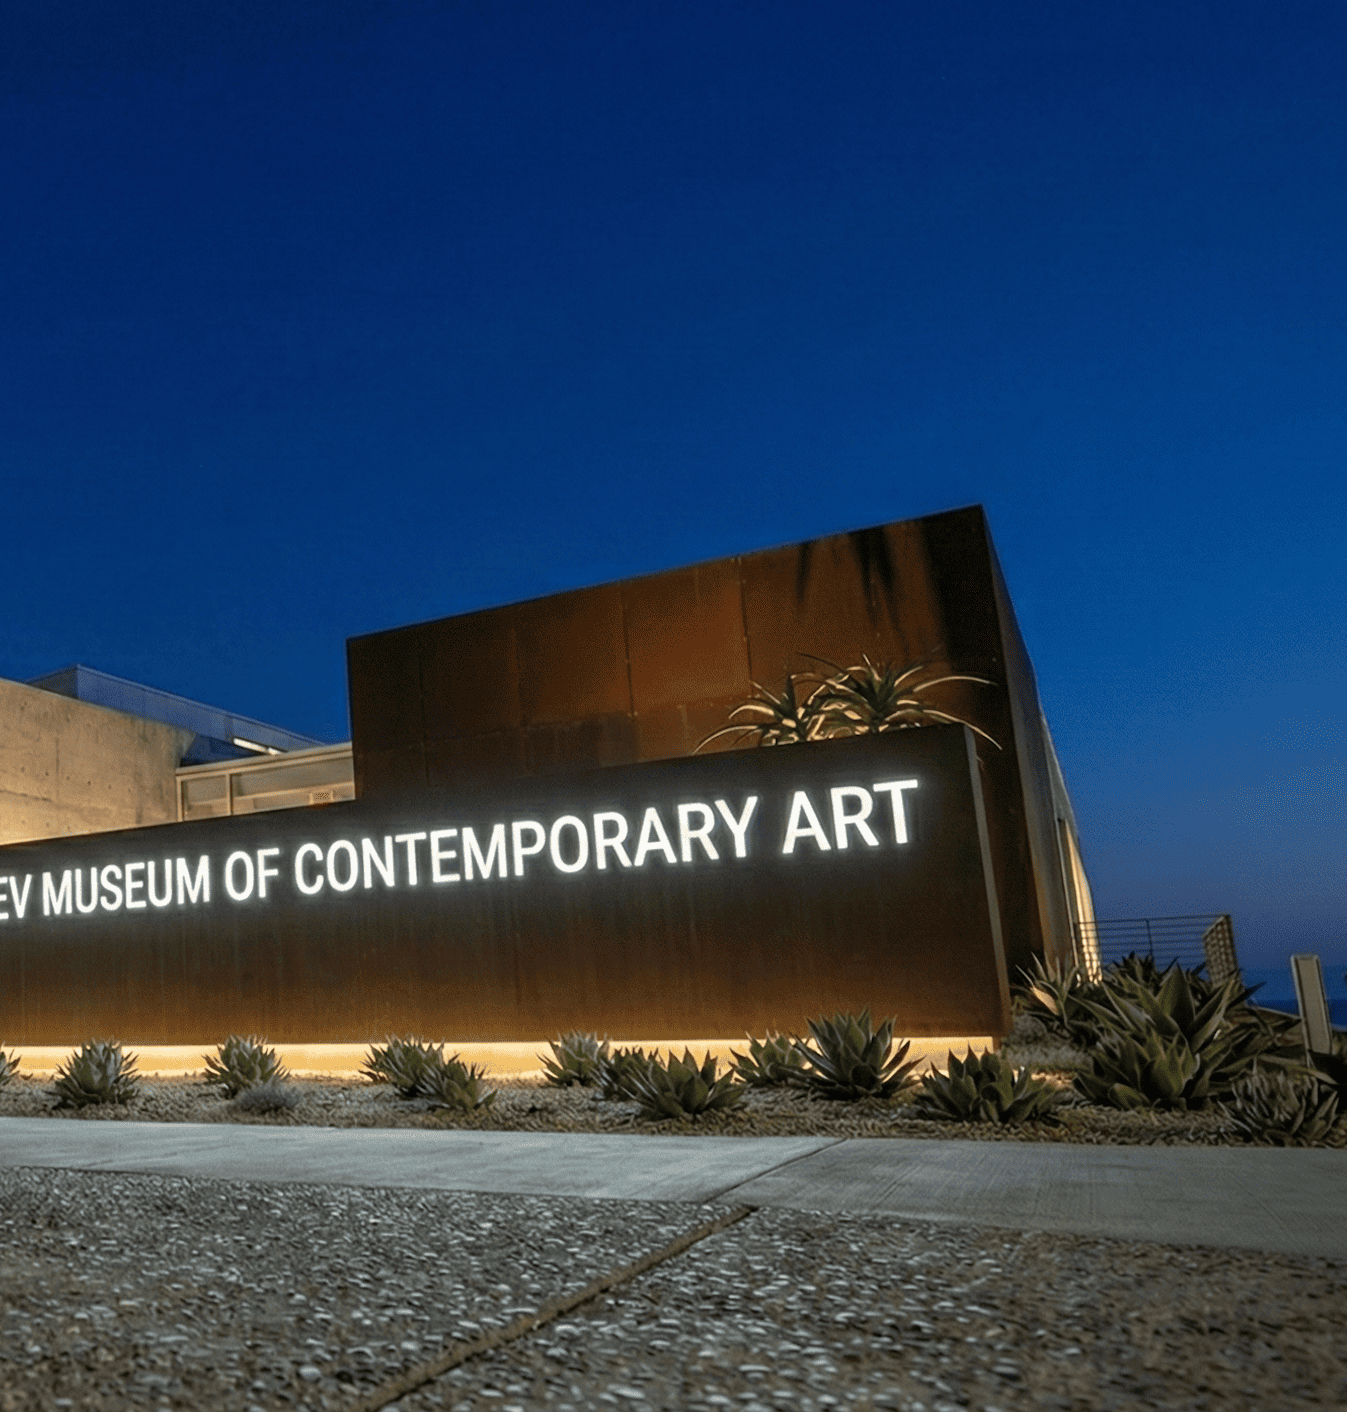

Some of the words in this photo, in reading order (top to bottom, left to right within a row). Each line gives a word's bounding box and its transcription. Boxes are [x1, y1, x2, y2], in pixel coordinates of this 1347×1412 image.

[42, 855, 210, 916] MUSEUM
[225, 847, 280, 901] OF
[294, 796, 758, 895] CONTEMPORARY
[782, 779, 919, 854] ART
